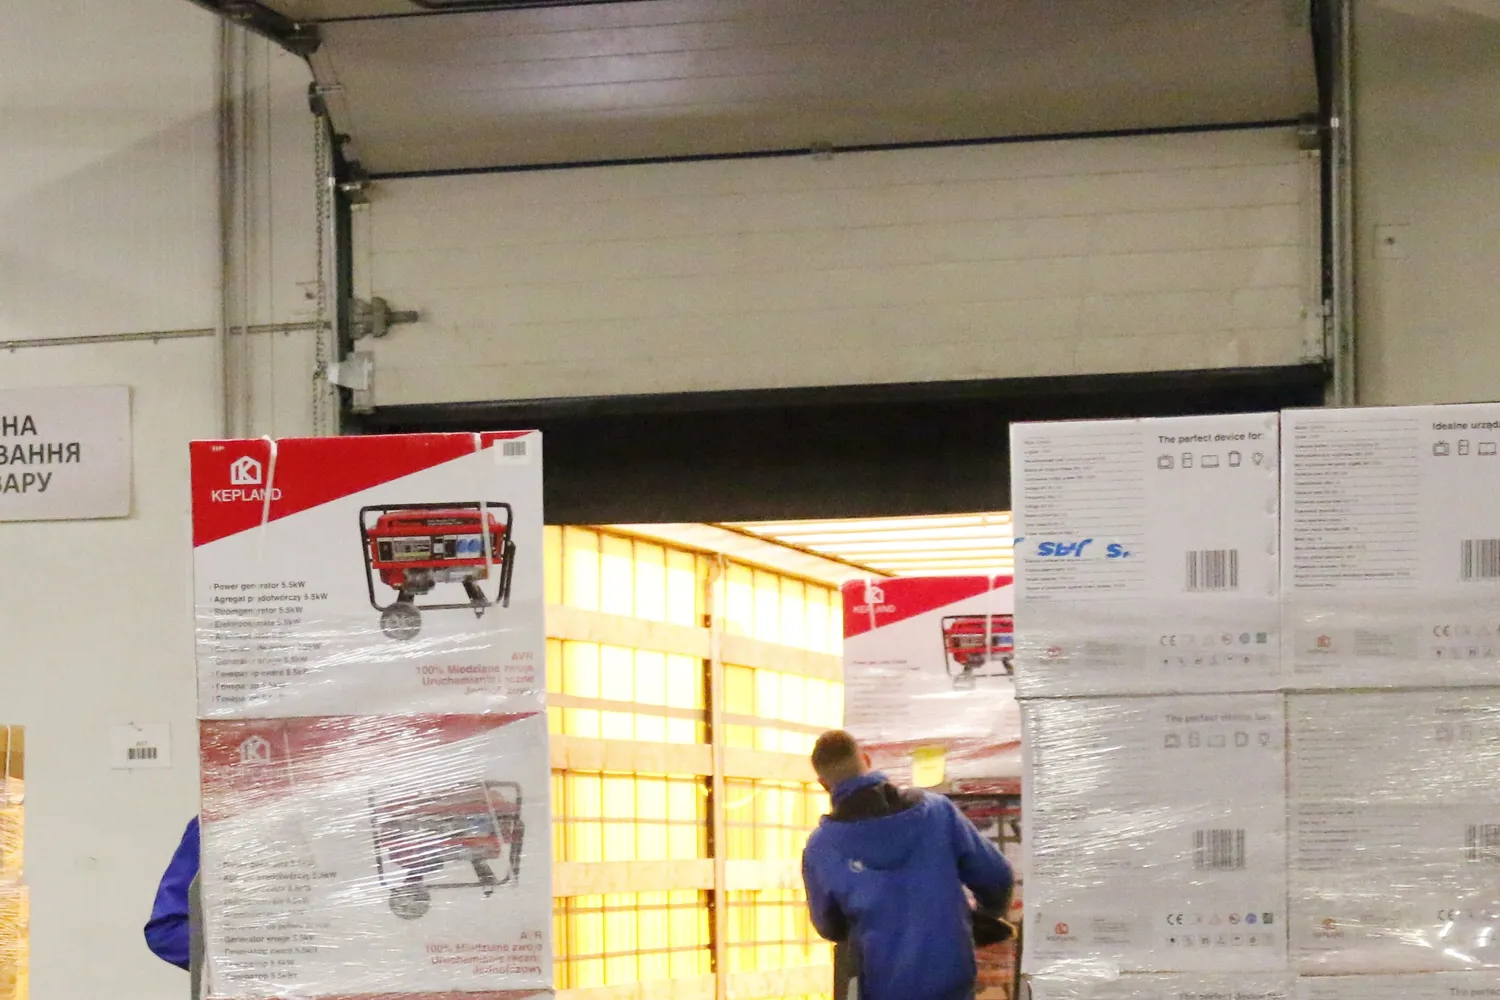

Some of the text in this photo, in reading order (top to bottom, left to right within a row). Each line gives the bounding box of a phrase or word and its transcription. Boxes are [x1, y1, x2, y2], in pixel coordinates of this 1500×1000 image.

[1432, 421, 1468, 430] Idealne
[1158, 435, 1175, 443] The
[1179, 434, 1211, 444] perfect
[1214, 433, 1245, 442] device
[241, 582, 279, 591] genrator
[281, 581, 306, 589] 5.5kW
[214, 595, 245, 604] Agregat
[214, 608, 276, 616] Stromgenrator
[520, 931, 542, 940] AR
